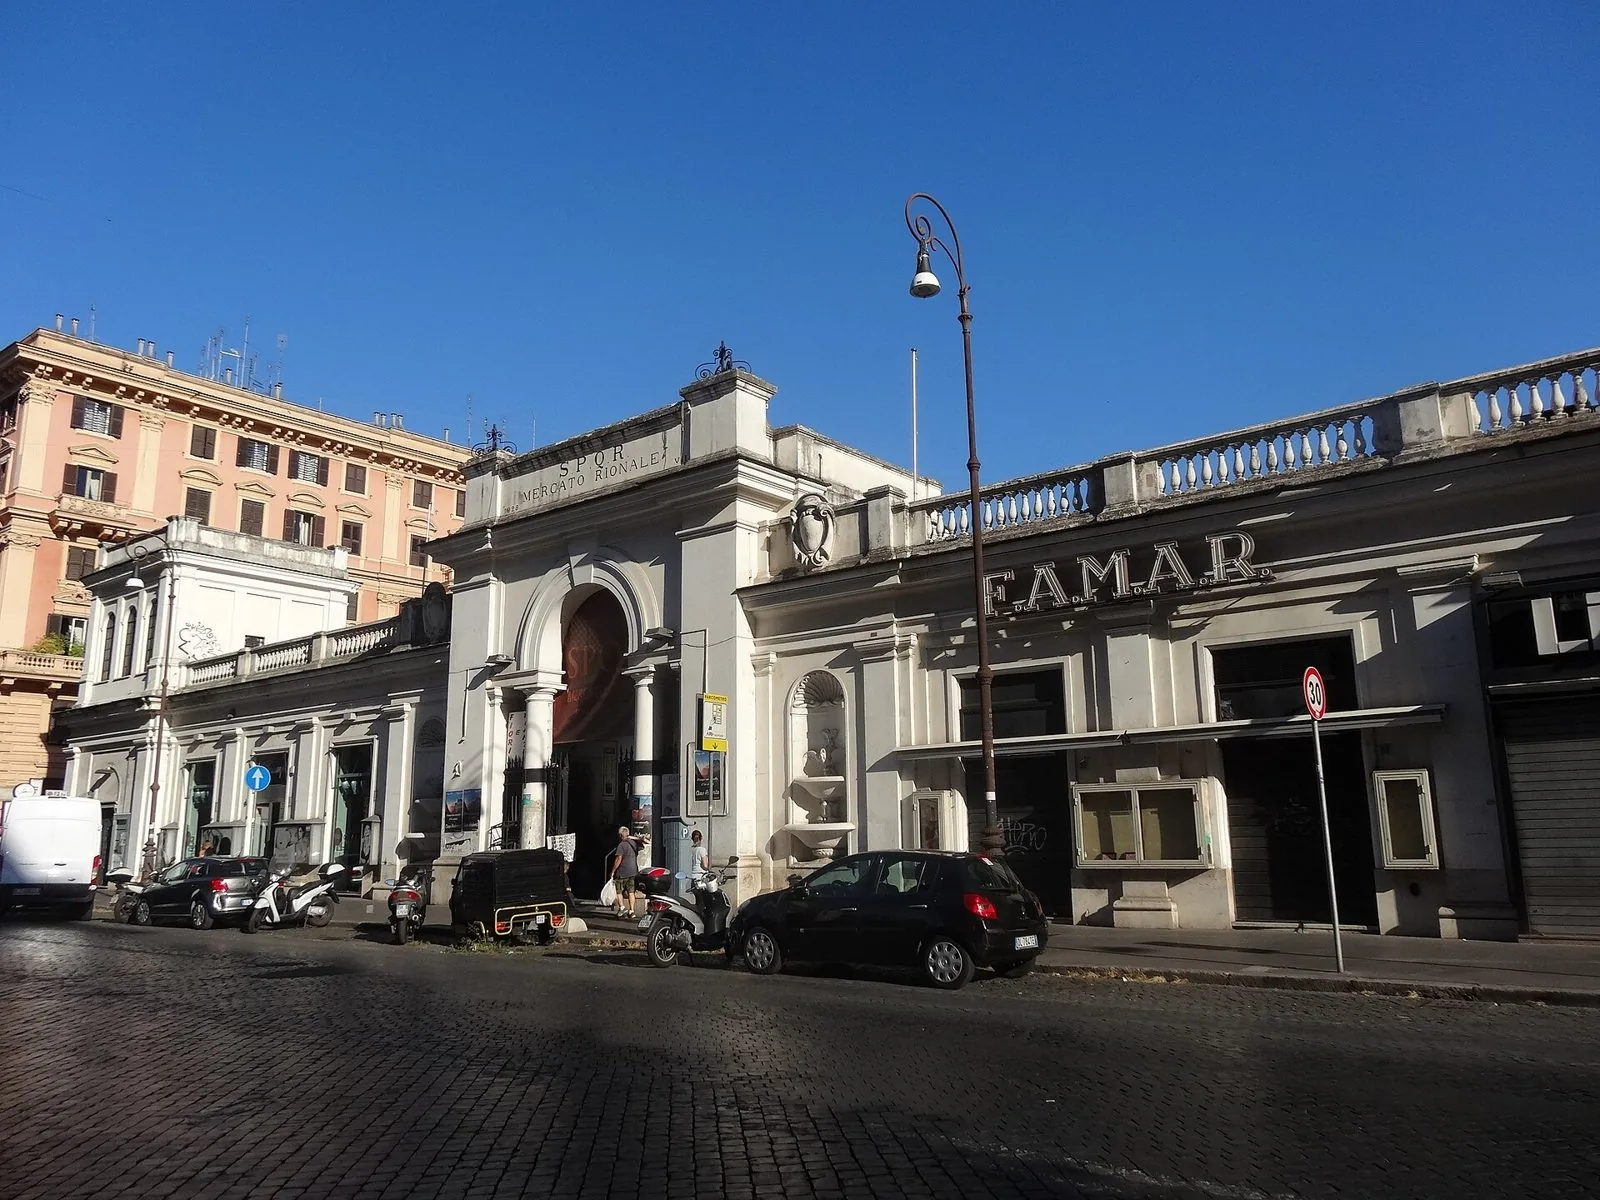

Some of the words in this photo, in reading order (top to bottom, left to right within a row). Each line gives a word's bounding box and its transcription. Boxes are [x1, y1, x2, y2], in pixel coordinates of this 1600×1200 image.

[523, 474, 585, 503] MERCATO
[594, 451, 659, 482] RIONALE
[1309, 680, 1322, 706] 30
[682, 828, 688, 838] P
